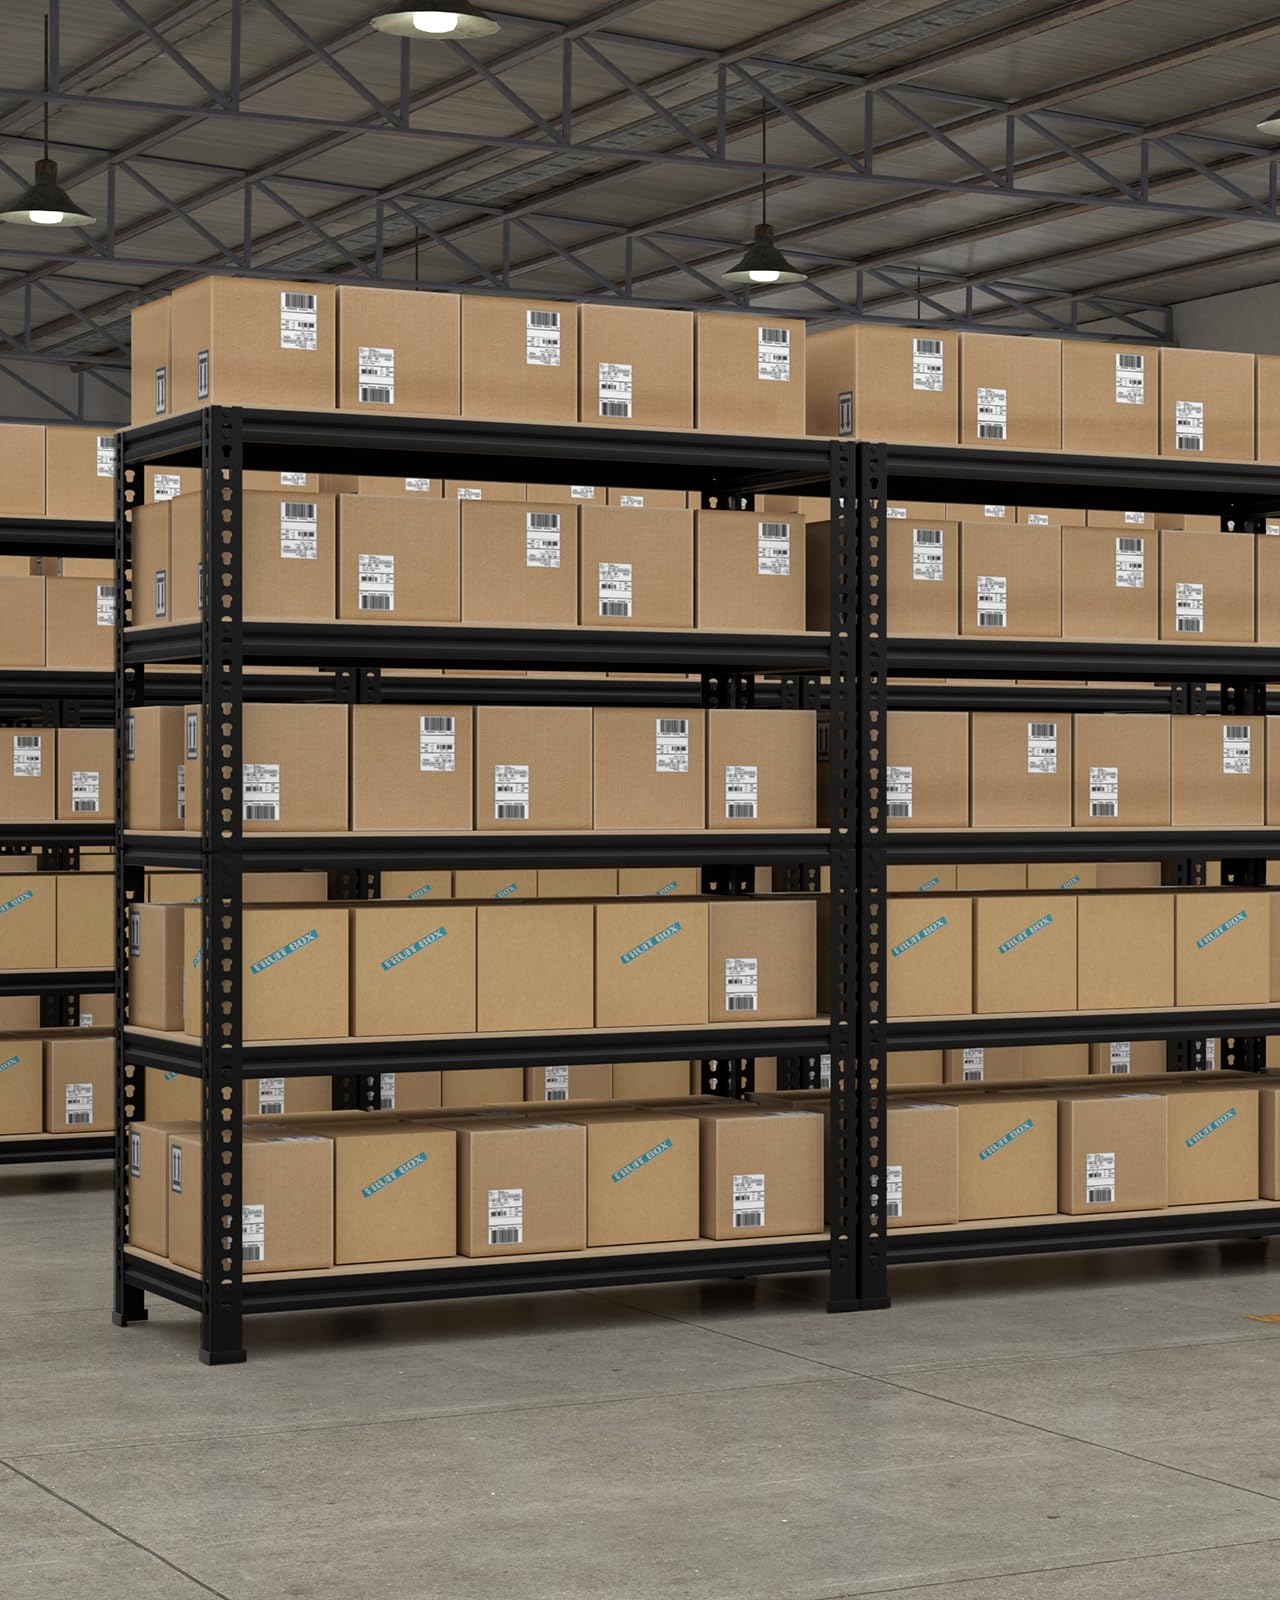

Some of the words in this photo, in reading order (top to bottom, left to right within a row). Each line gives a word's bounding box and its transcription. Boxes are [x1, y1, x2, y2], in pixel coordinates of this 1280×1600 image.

[623, 939, 654, 961] FRUIT
[655, 926, 678, 943] BOX
[893, 933, 921, 955] FRUIT
[922, 919, 943, 936] BOX
[1001, 930, 1028, 951] FRUIT
[1029, 917, 1050, 934] BOX
[1199, 925, 1224, 946] FRUIT
[1224, 913, 1243, 930] BOX
[252, 947, 287, 972] FRUIT
[288, 933, 314, 951] BOX
[383, 945, 417, 969] FRUIT
[418, 931, 443, 948] BOX
[982, 1136, 1009, 1158] FRUIT
[1009, 1122, 1031, 1140] BOX
[1188, 1123, 1213, 1145] FRUIT
[1214, 1111, 1233, 1128] BOX
[364, 1171, 397, 1195] FRUIT
[398, 1156, 422, 1174] BOX
[614, 1157, 645, 1181] FRUIT
[645, 1142, 668, 1160] BOX
